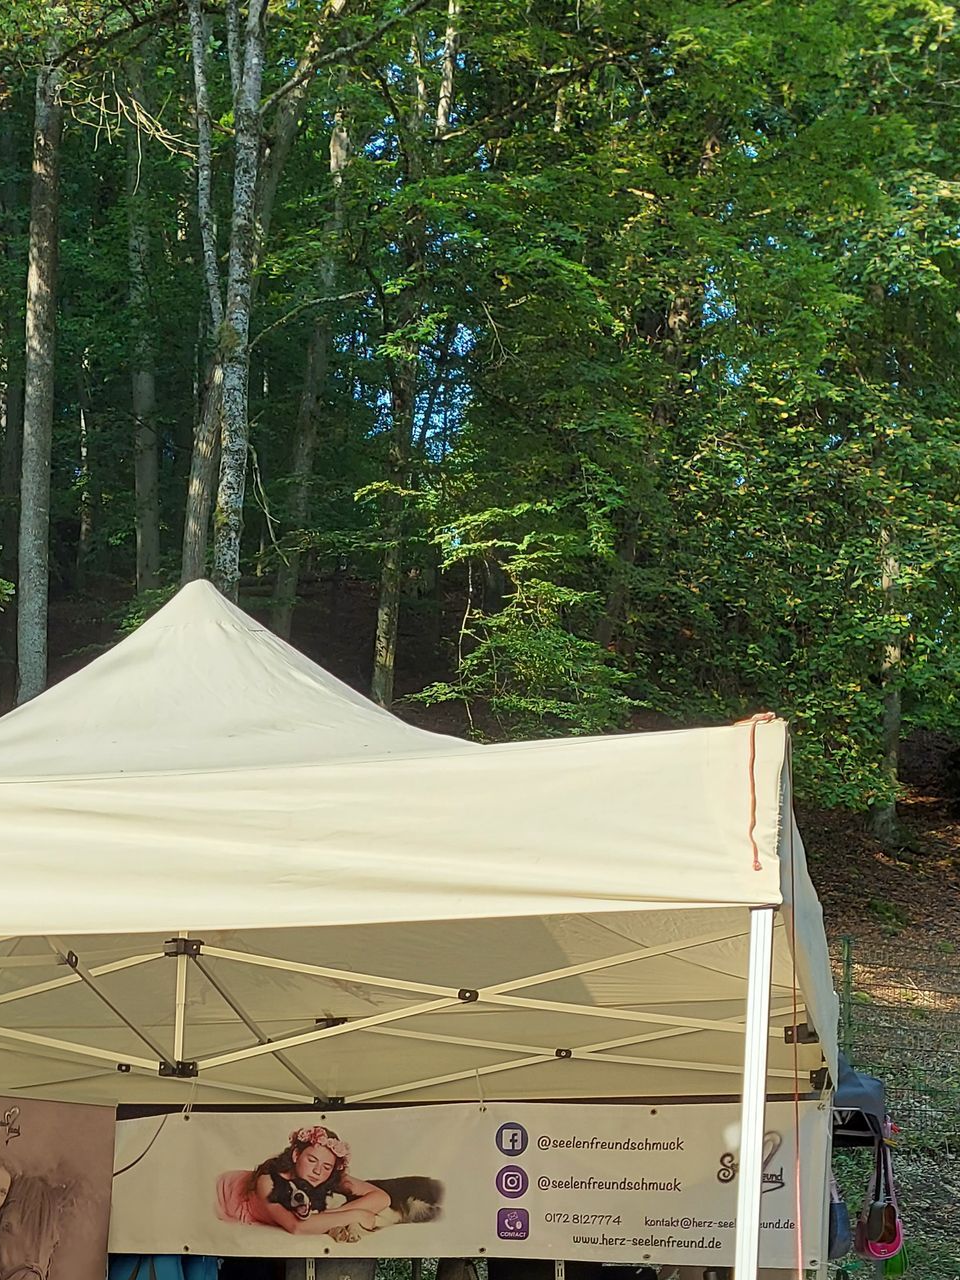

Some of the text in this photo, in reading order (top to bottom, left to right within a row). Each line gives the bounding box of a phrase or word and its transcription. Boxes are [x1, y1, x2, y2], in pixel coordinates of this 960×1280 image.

[537, 1135, 685, 1151] @seelenfreundschmuck
[537, 1176, 682, 1192] @seelenfreundschmuck
[544, 1212, 570, 1223] 0172
[572, 1213, 622, 1226] 8127774
[572, 1234, 722, 1249] www.herz-seelenfreund.de
